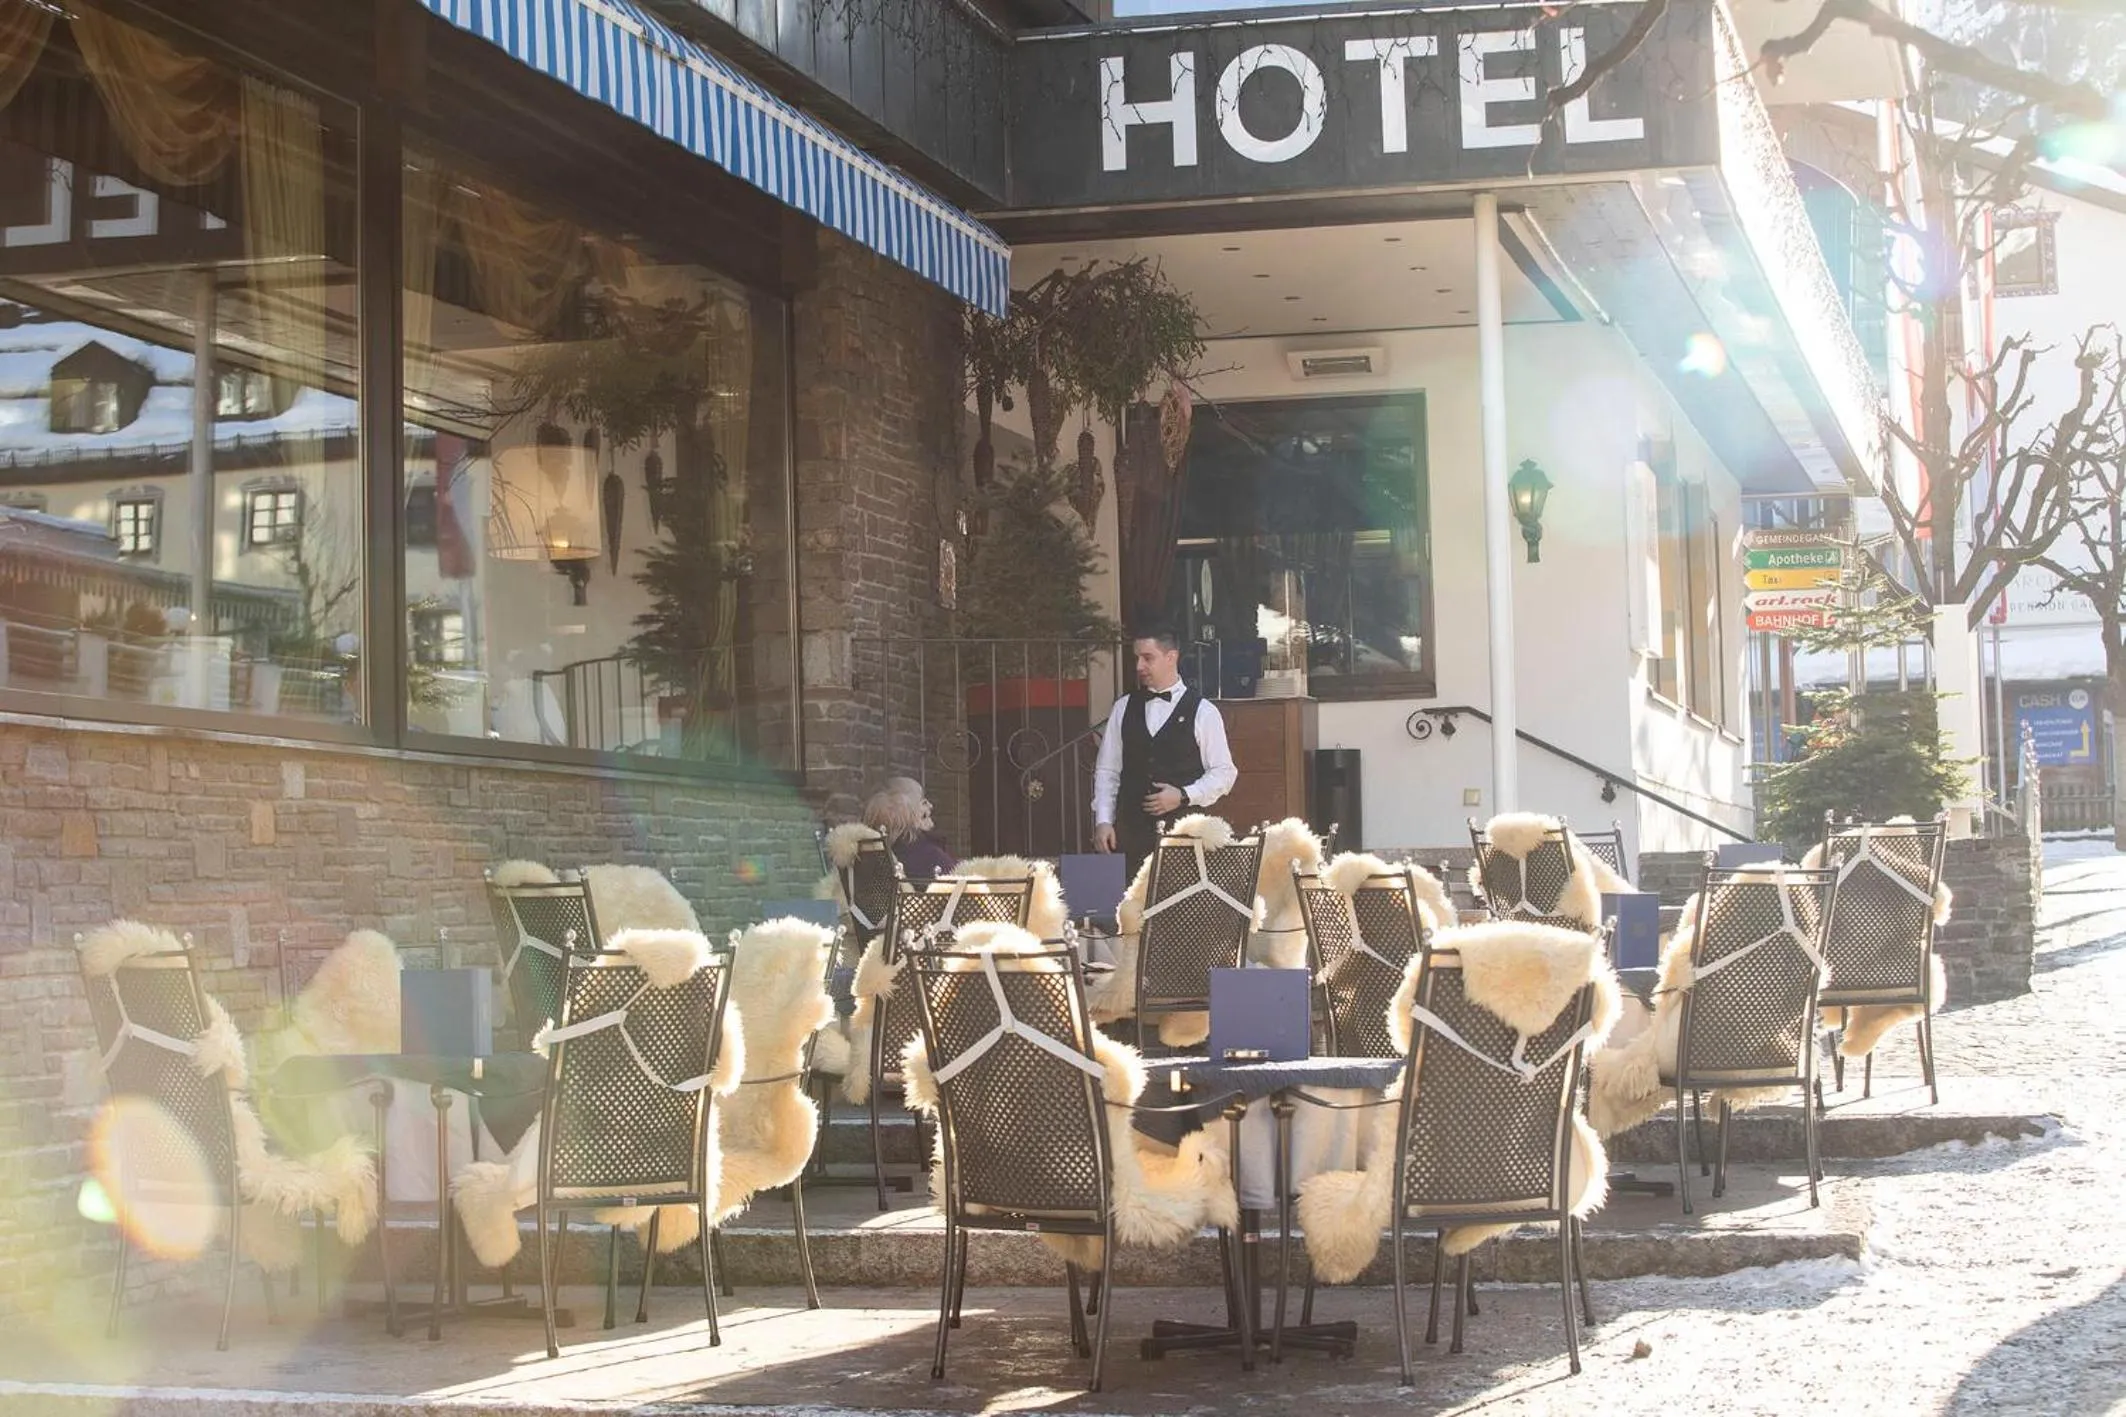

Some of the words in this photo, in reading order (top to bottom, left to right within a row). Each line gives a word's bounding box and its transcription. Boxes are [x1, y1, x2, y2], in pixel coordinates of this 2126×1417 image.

[1100, 27, 1644, 171] HOTEL
[1768, 551, 1824, 566] Apotheke
[1755, 593, 1837, 606] arl.rock
[1755, 614, 1819, 626] BAHNHOF
[2019, 694, 2061, 707] CASH
